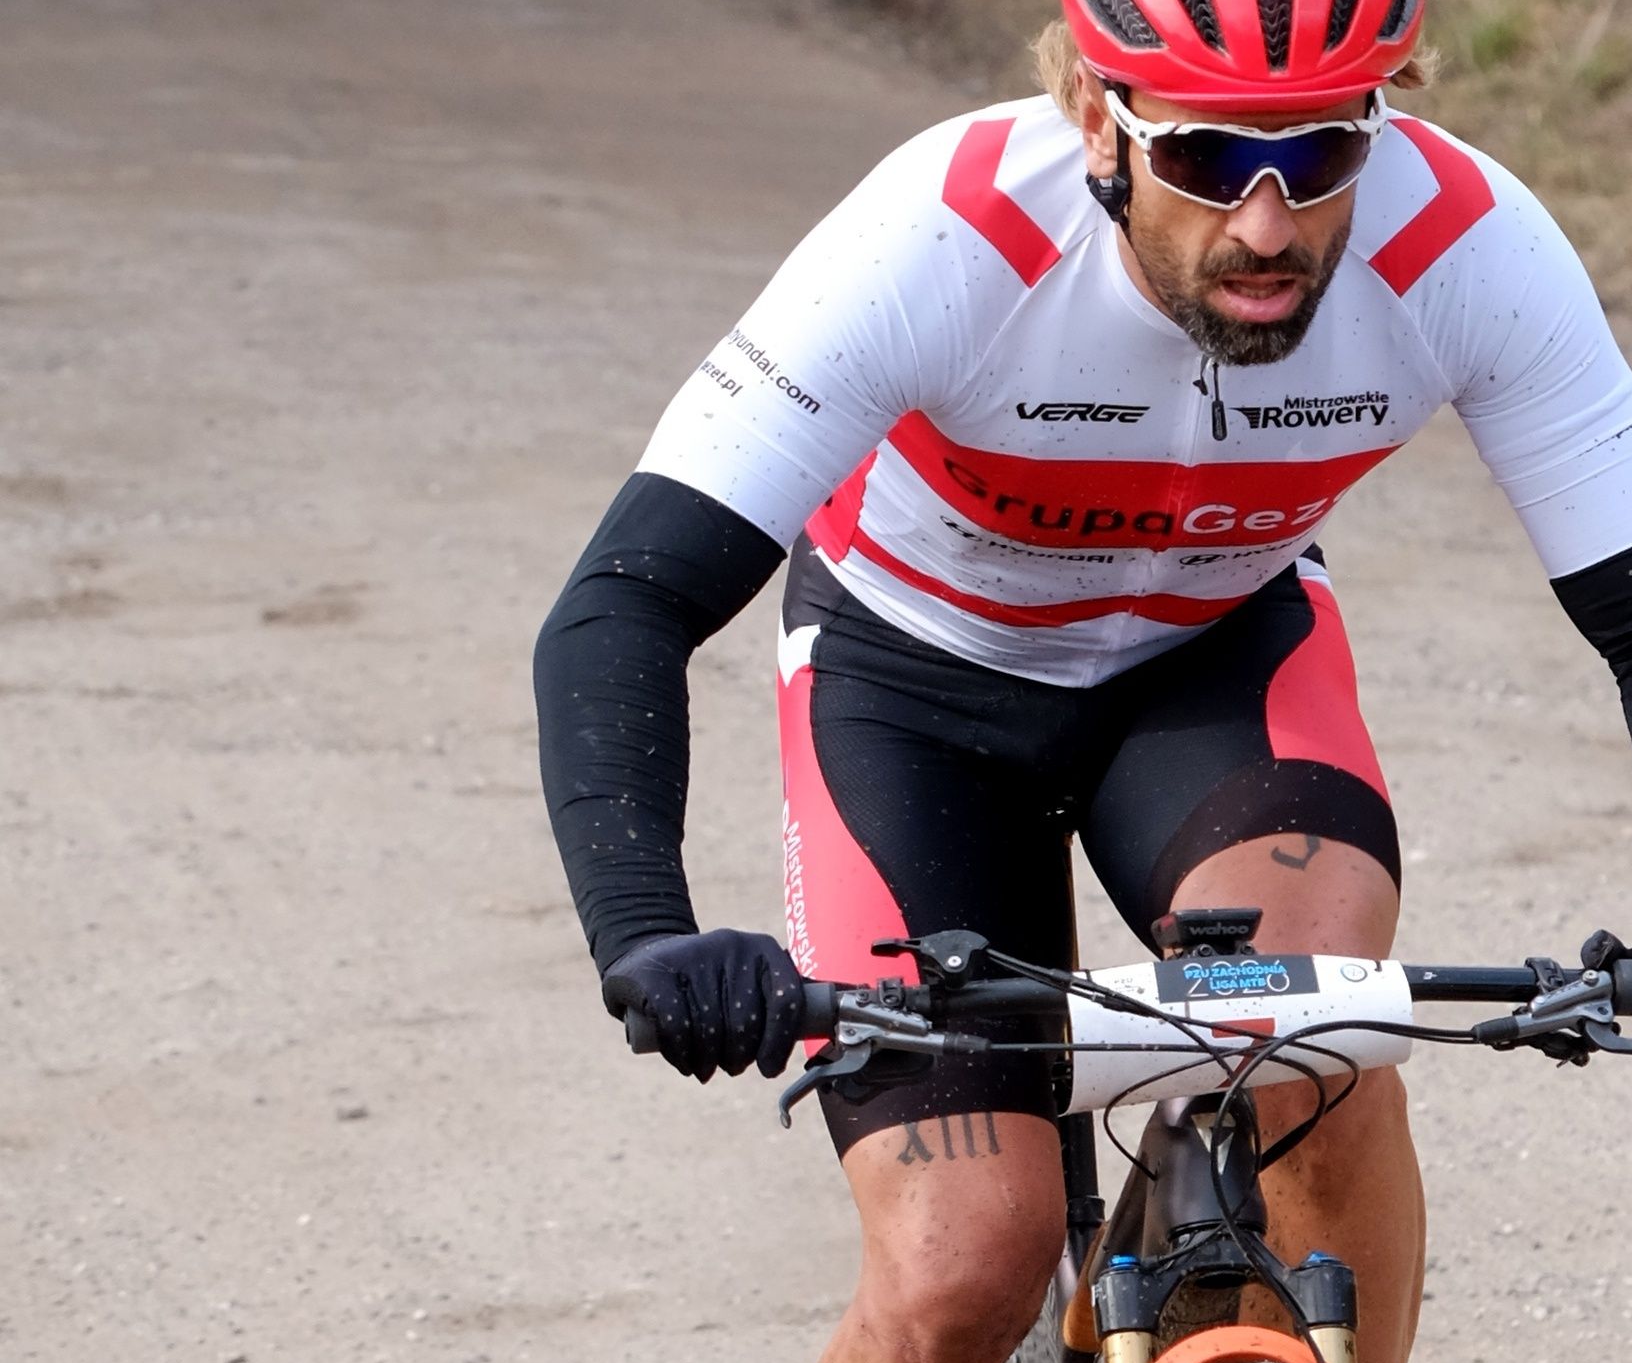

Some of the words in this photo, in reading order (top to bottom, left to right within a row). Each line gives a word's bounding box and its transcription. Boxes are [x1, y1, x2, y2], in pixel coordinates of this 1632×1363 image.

[1284, 391, 1389, 409] Mistrzowskie
[1016, 402, 1150, 423] VERGE
[1261, 404, 1389, 429] Rowery
[943, 457, 1348, 537] GrupaGez
[1189, 922, 1249, 935] wahoo
[1184, 969, 1209, 979] PZU
[1211, 965, 1287, 977] ZACHODNIA
[1210, 977, 1238, 990] LIGA
[1240, 977, 1266, 988] MTB
